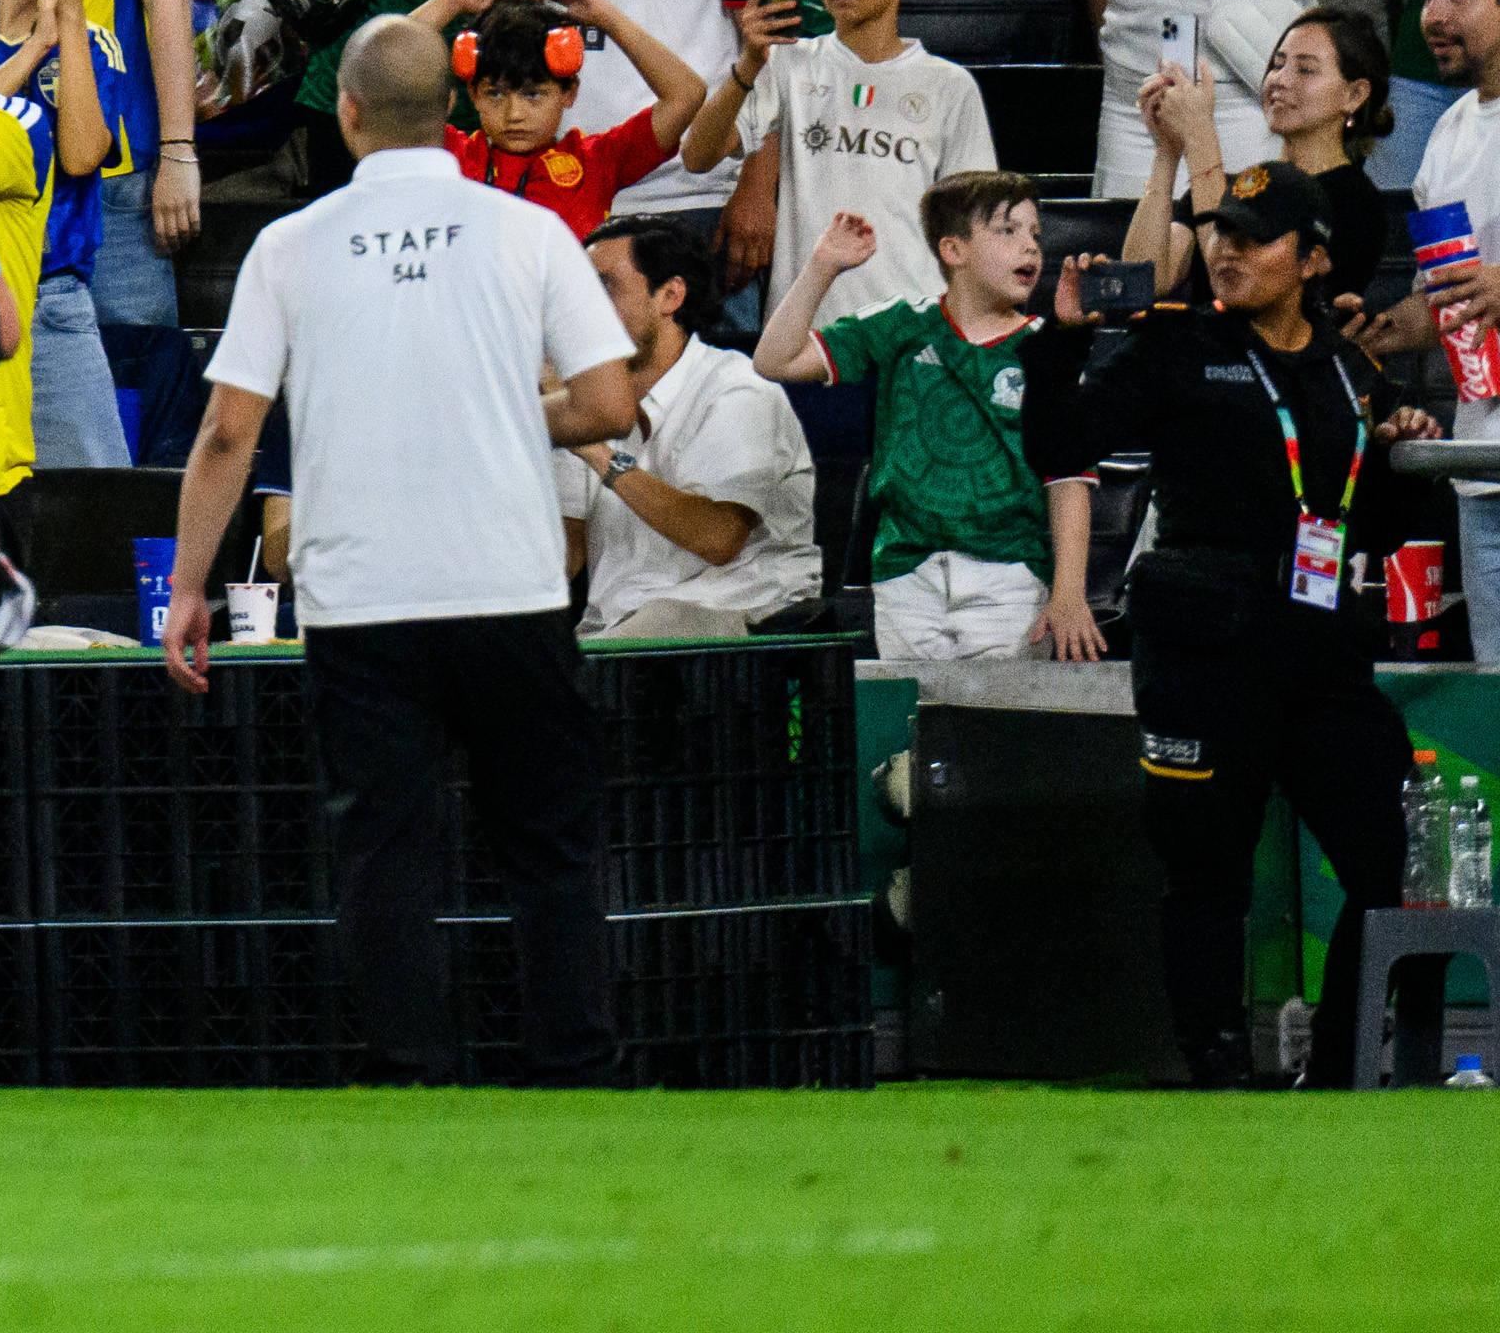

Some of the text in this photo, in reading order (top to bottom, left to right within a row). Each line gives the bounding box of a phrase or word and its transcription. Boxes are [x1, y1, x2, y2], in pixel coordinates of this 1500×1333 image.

[835, 124, 921, 166] MSC
[349, 224, 464, 256] STAFF
[392, 261, 428, 284] 544
